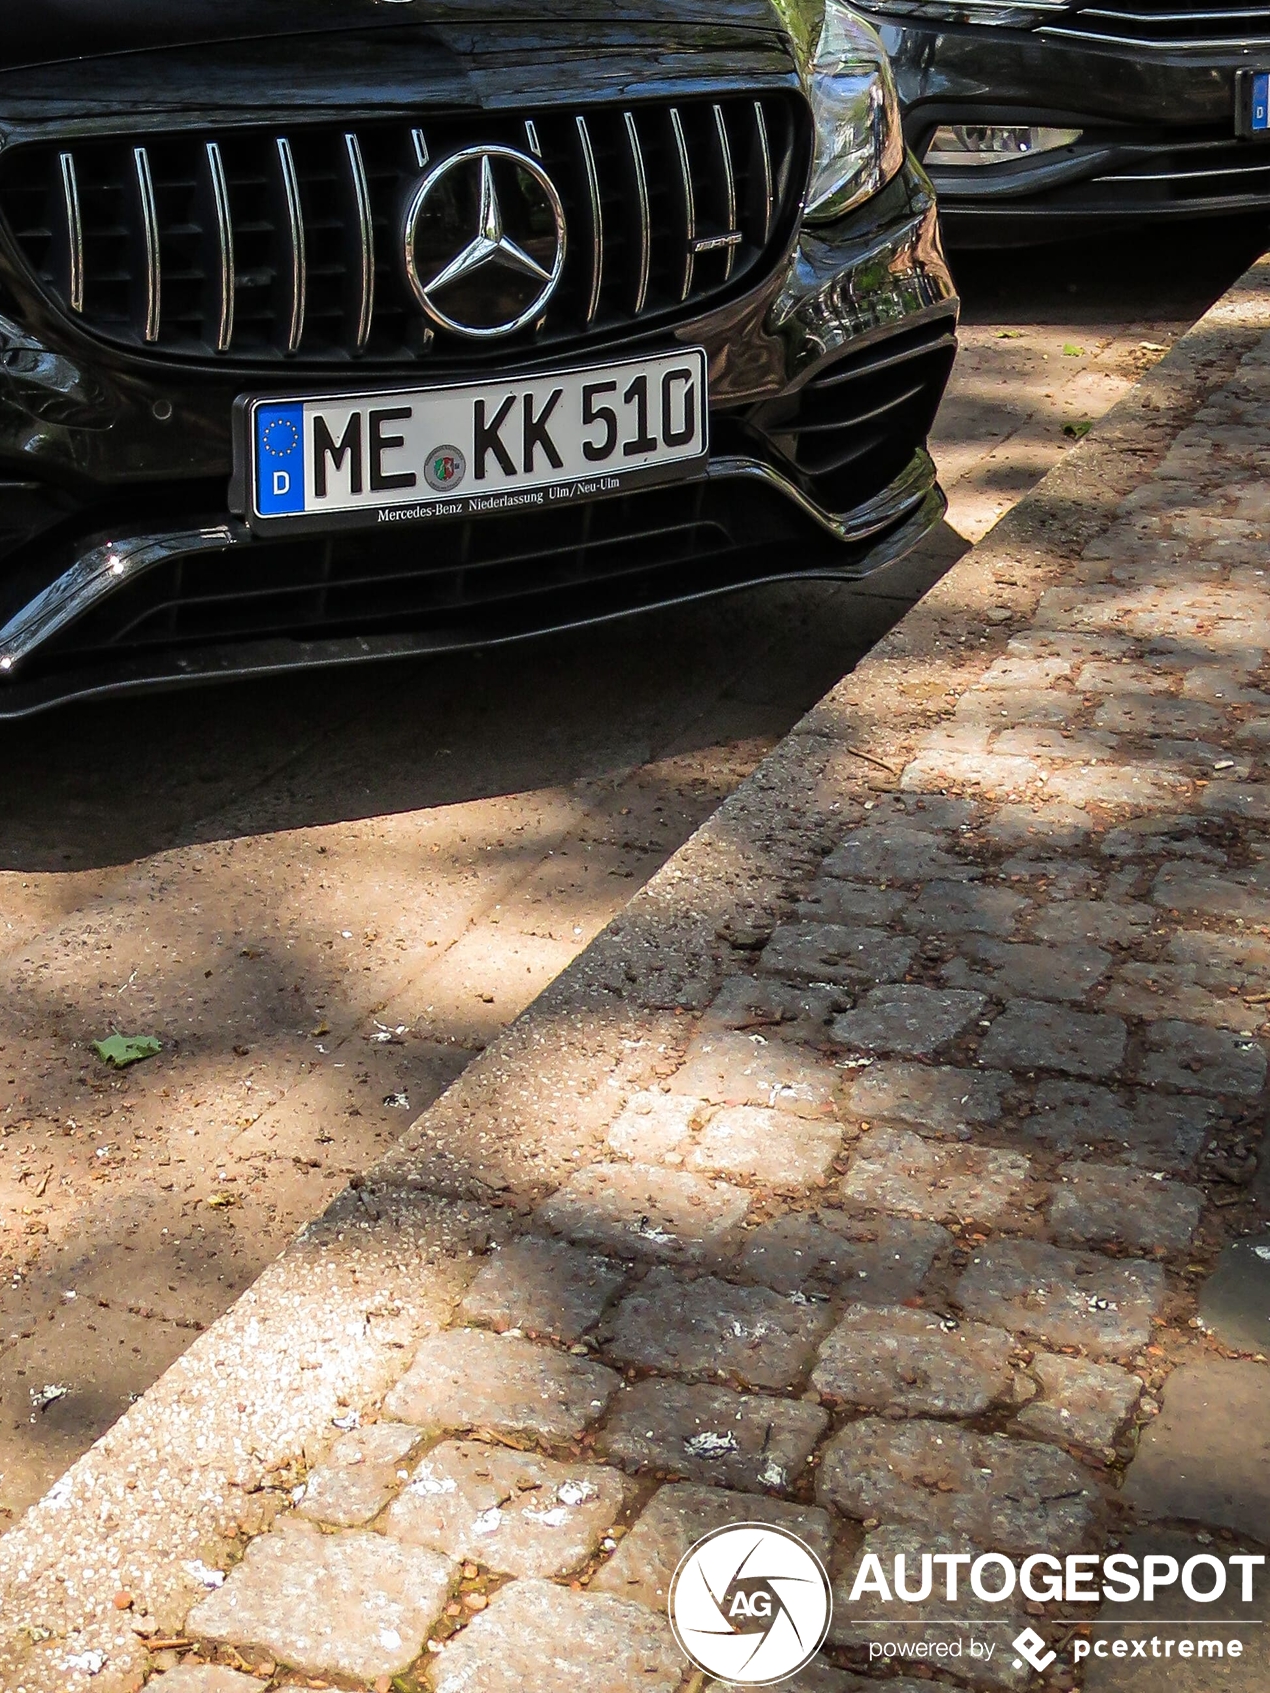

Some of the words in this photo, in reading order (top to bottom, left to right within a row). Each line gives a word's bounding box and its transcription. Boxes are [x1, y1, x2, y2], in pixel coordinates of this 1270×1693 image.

[1256, 106, 1264, 119] D
[273, 471, 290, 495] D
[313, 406, 417, 498] ME
[473, 388, 565, 480] KK
[582, 368, 696, 462] 510
[377, 503, 463, 523] Mercedes-Benz
[468, 491, 544, 512] Niederlassung
[548, 477, 620, 500] Ulm/Neu-Ulm
